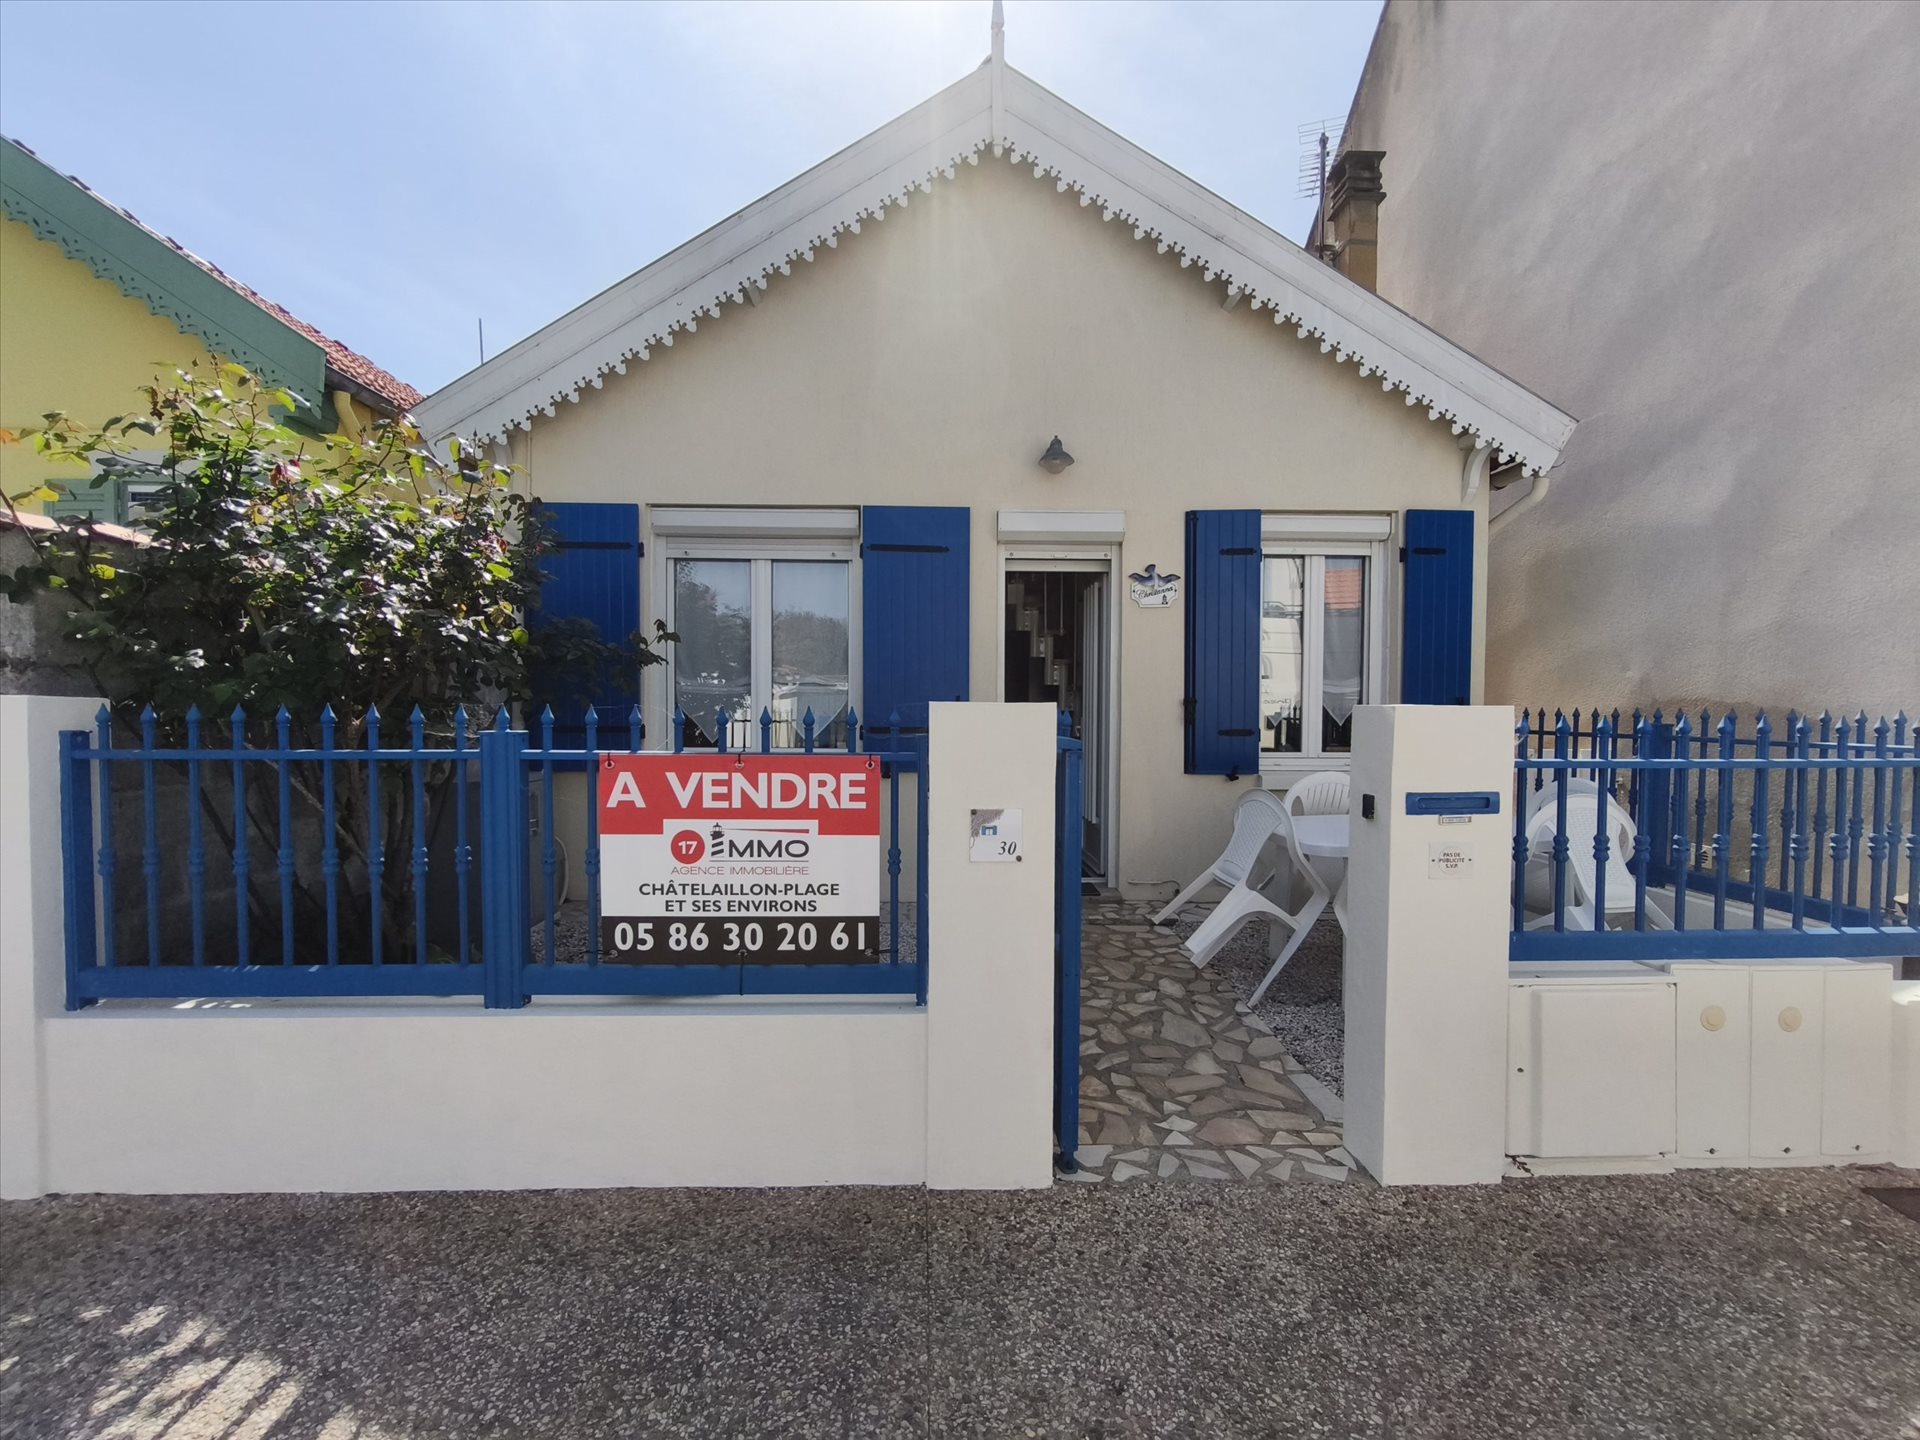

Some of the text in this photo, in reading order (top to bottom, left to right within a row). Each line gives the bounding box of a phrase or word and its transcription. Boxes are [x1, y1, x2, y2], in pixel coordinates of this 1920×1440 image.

[606, 771, 867, 809] A VENDRE
[678, 840, 698, 855] 17
[998, 841, 1017, 855] 30
[670, 865, 809, 875] AGENCE IMMOBILIÈRE
[639, 880, 840, 896] CHÂTELAILLON-PLAGE
[665, 899, 817, 913] ET SES ENVIRONS
[614, 922, 866, 951] 05 86 30 20 61
